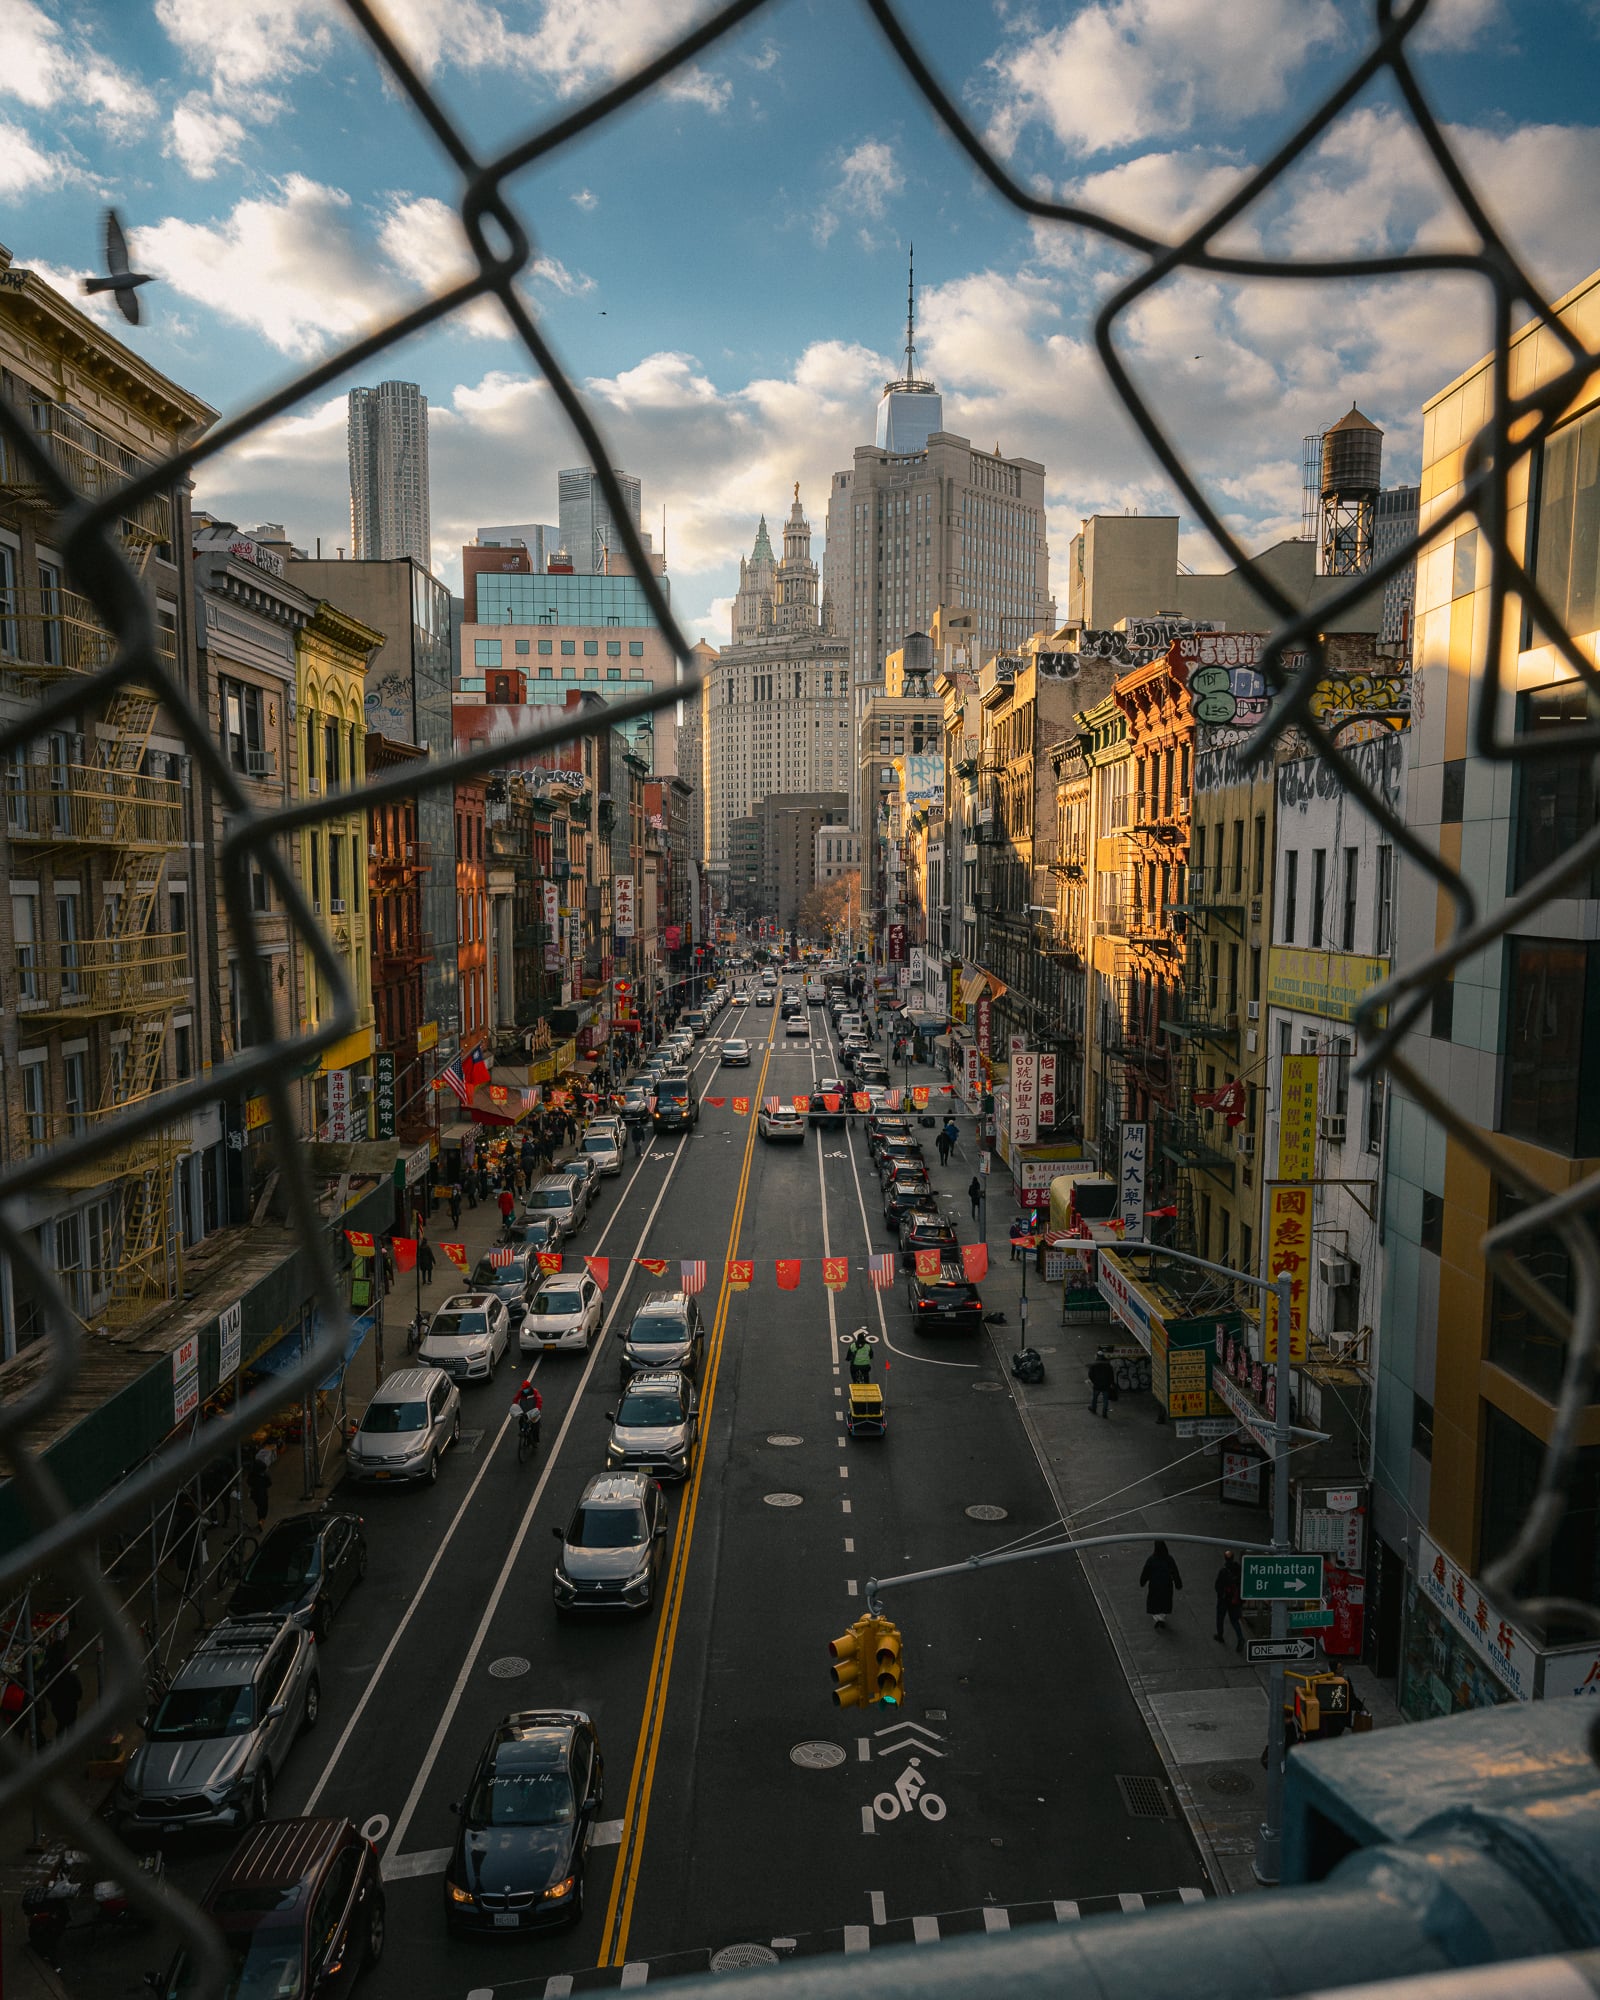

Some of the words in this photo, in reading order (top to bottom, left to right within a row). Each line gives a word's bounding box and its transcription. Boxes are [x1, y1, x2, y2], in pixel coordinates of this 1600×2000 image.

[1249, 1563, 1315, 1575] Manhattan
[1256, 1579, 1269, 1590] Br
[1446, 1593, 1454, 1610] DA
[1458, 1608, 1483, 1643] HERBAL
[1488, 1640, 1521, 1685] MEDICINE
[1254, 1646, 1273, 1655] ONE
[1285, 1645, 1306, 1654] WAY
